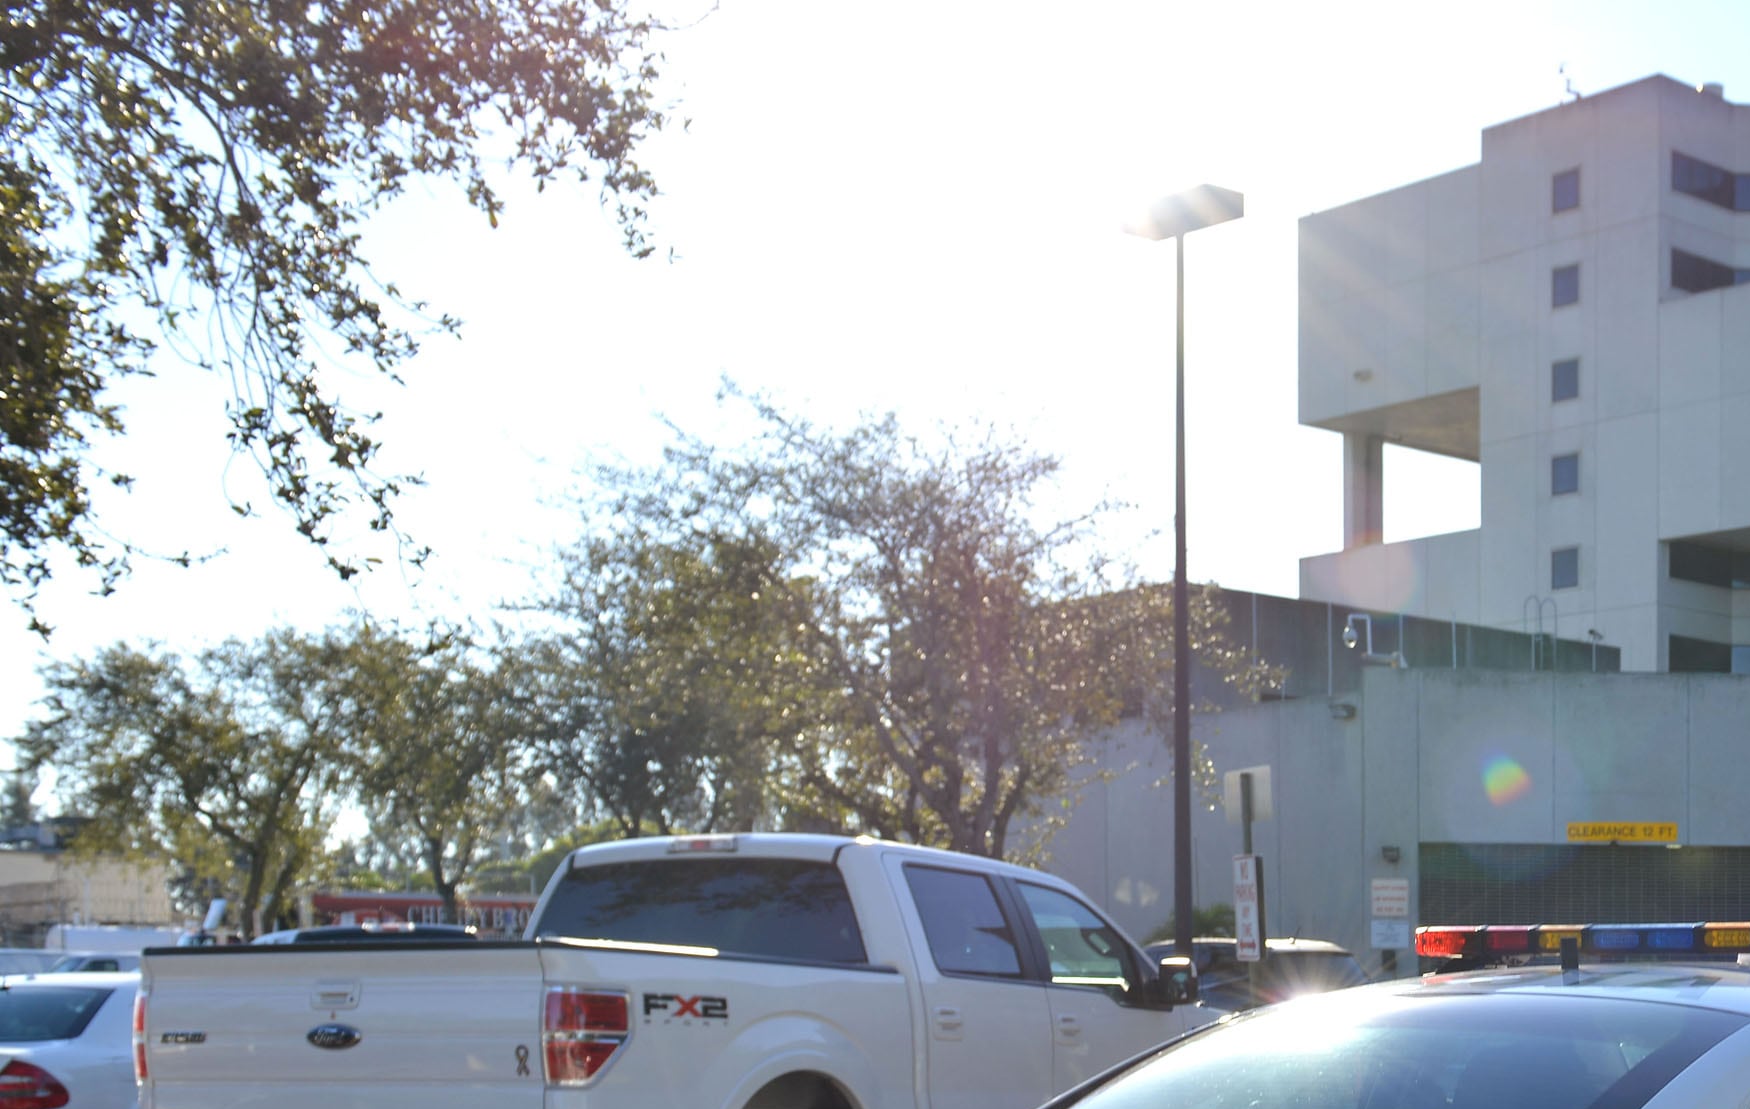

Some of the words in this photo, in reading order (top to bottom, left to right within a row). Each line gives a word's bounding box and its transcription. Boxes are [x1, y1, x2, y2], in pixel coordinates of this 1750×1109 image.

[1567, 825, 1636, 838] CLEARANCE
[1643, 825, 1654, 838] 12
[1659, 825, 1673, 838] FT
[643, 993, 728, 1018] FX2
